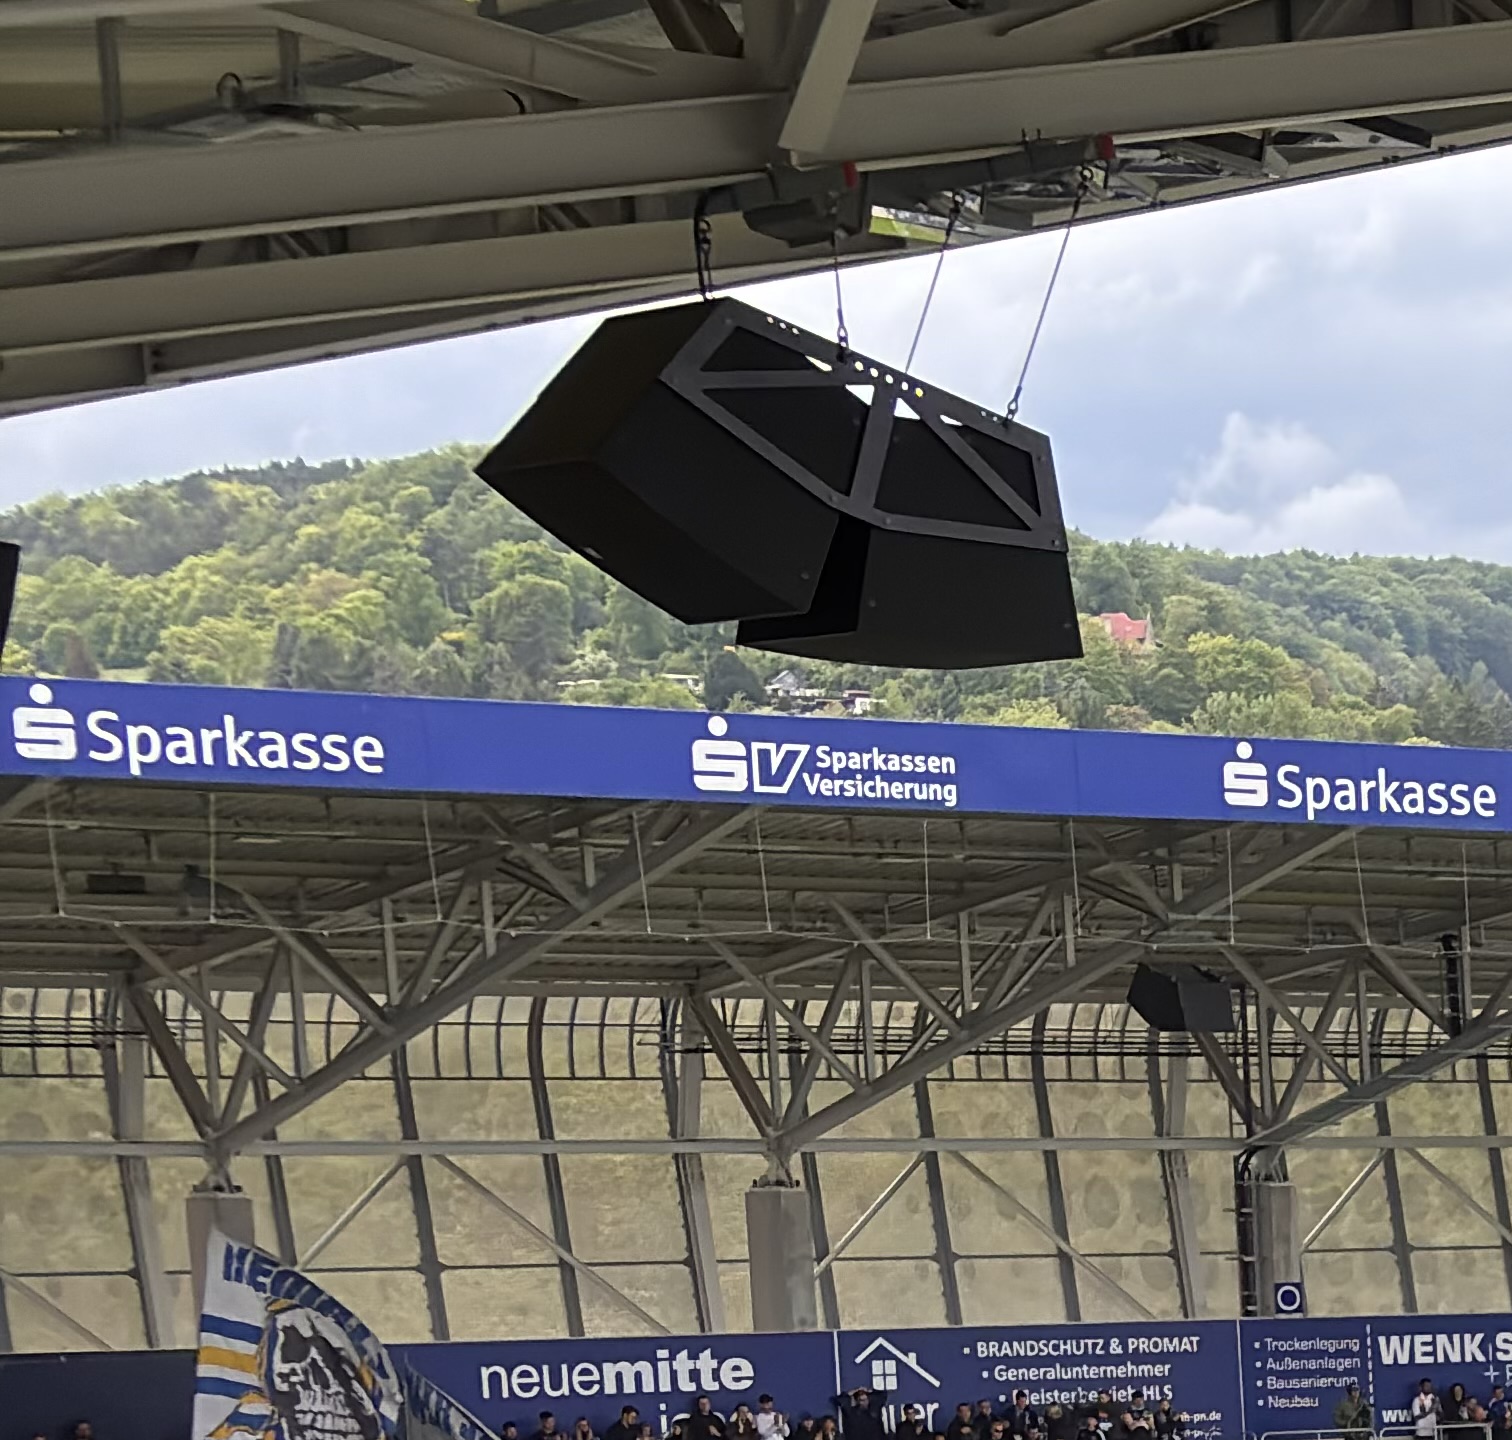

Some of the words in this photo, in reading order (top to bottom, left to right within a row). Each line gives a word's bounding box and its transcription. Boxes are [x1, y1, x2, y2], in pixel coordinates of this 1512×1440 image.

[87, 712, 385, 776] Sparkasse
[816, 743, 957, 777] Sparkassen
[804, 772, 958, 807] Versicherung
[1277, 765, 1497, 821] Sparkasse
[976, 1339, 1105, 1358] BRANDSCHUTZ
[1110, 1338, 1123, 1355] &
[1127, 1336, 1200, 1355] PROMAT
[1265, 1336, 1360, 1354] Trockenlegung
[1378, 1332, 1485, 1365] WENK
[480, 1348, 755, 1401] neuemitte
[994, 1363, 1171, 1382] Generalunternehmer
[1266, 1355, 1361, 1373] Außenanlagen
[1268, 1396, 1319, 1409] Neubau
